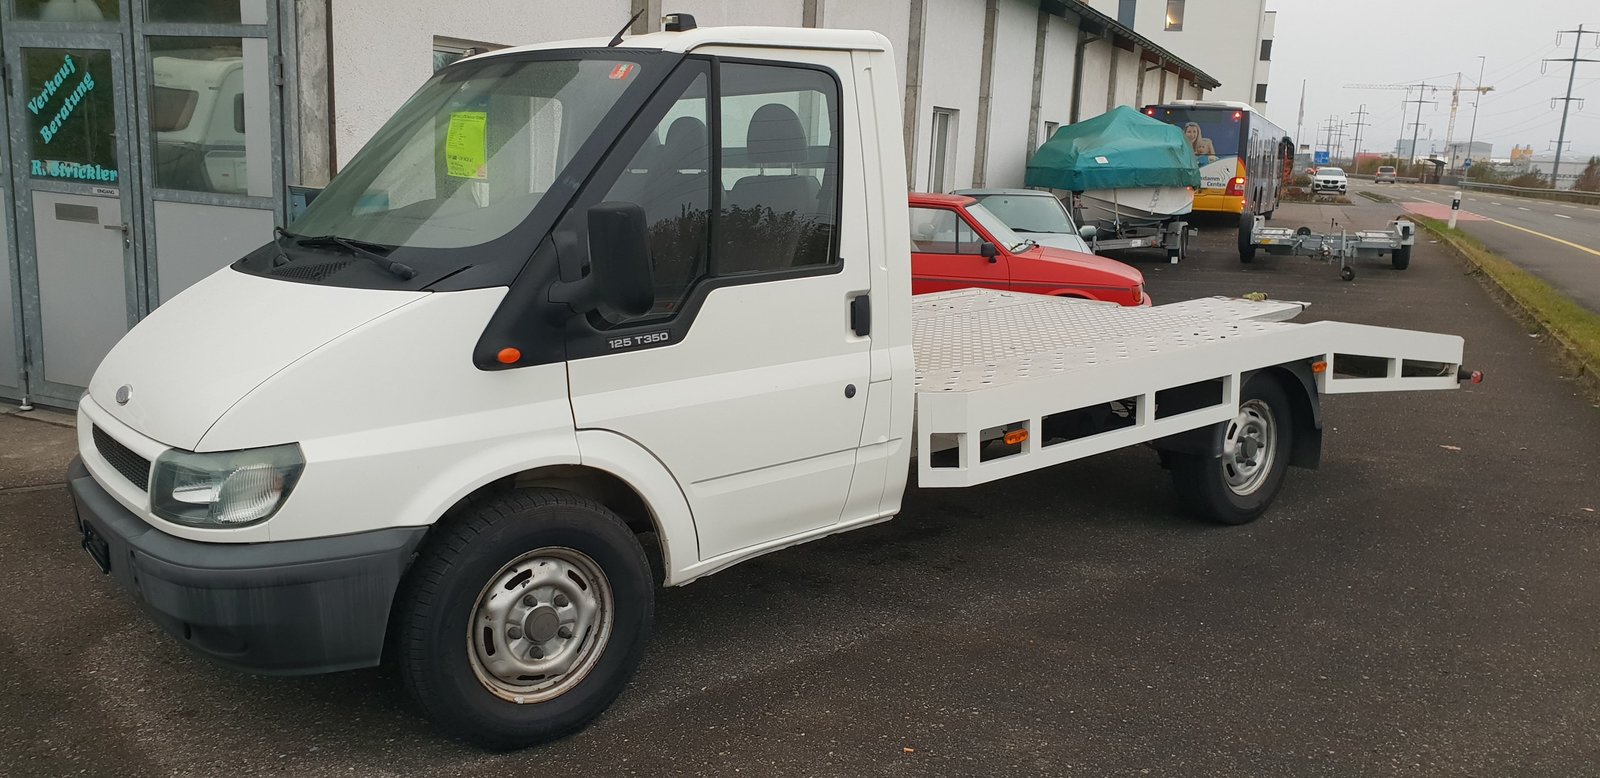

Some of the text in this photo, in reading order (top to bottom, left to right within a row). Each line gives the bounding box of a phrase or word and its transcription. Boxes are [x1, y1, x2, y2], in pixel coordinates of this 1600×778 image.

[28, 54, 75, 114] Verkauf
[40, 72, 94, 144] Beratung
[31, 160, 118, 181] R. Strickler
[608, 332, 669, 349] 125 T350
